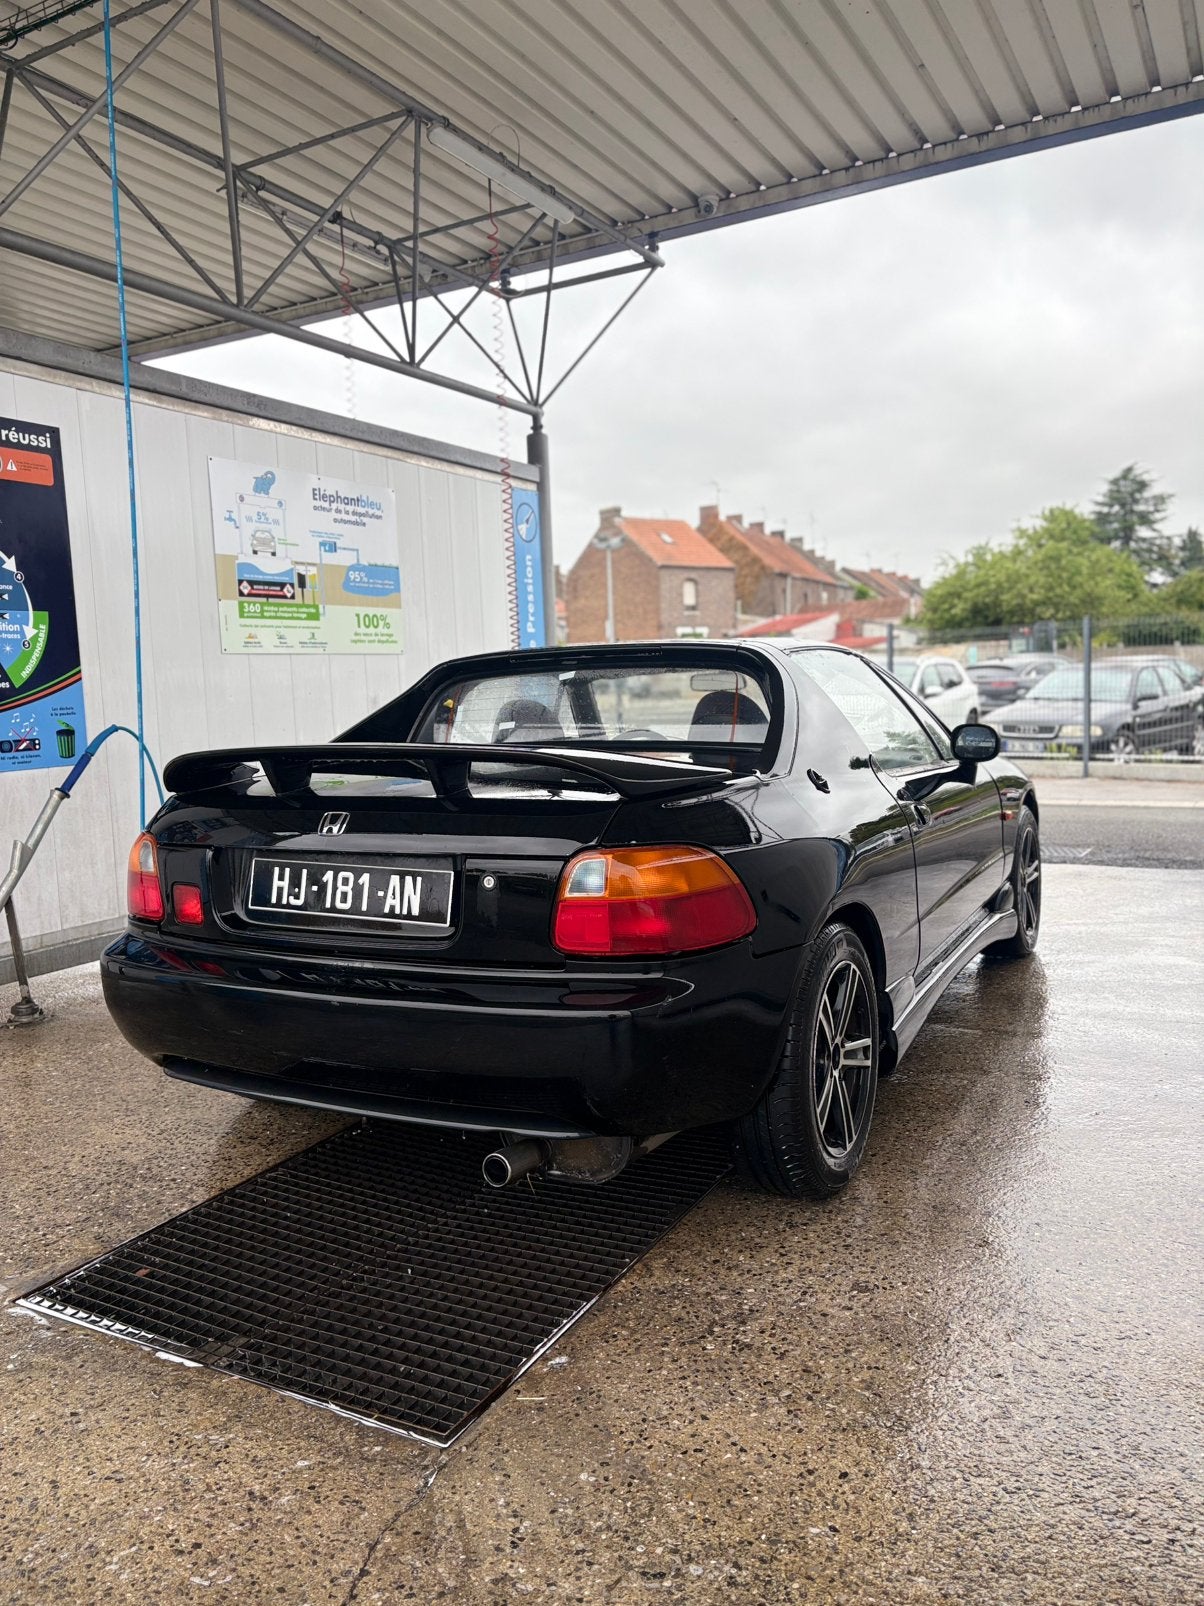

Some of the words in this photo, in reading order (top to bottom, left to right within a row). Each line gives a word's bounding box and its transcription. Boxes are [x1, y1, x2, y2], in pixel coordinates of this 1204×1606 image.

[1, 427, 51, 448] réussi
[256, 511, 270, 522] 5%
[313, 504, 333, 513] acteur
[334, 506, 342, 514] de
[344, 507, 350, 515] la
[351, 508, 383, 520] dépollution
[333, 517, 366, 527] automobile
[348, 571, 368, 583] 95%
[524, 555, 537, 633] Pression
[243, 603, 261, 612] 360
[355, 613, 391, 630] 100%
[20, 624, 46, 679] INDISPENSABLE
[270, 866, 422, 916] HJ-181-AN
